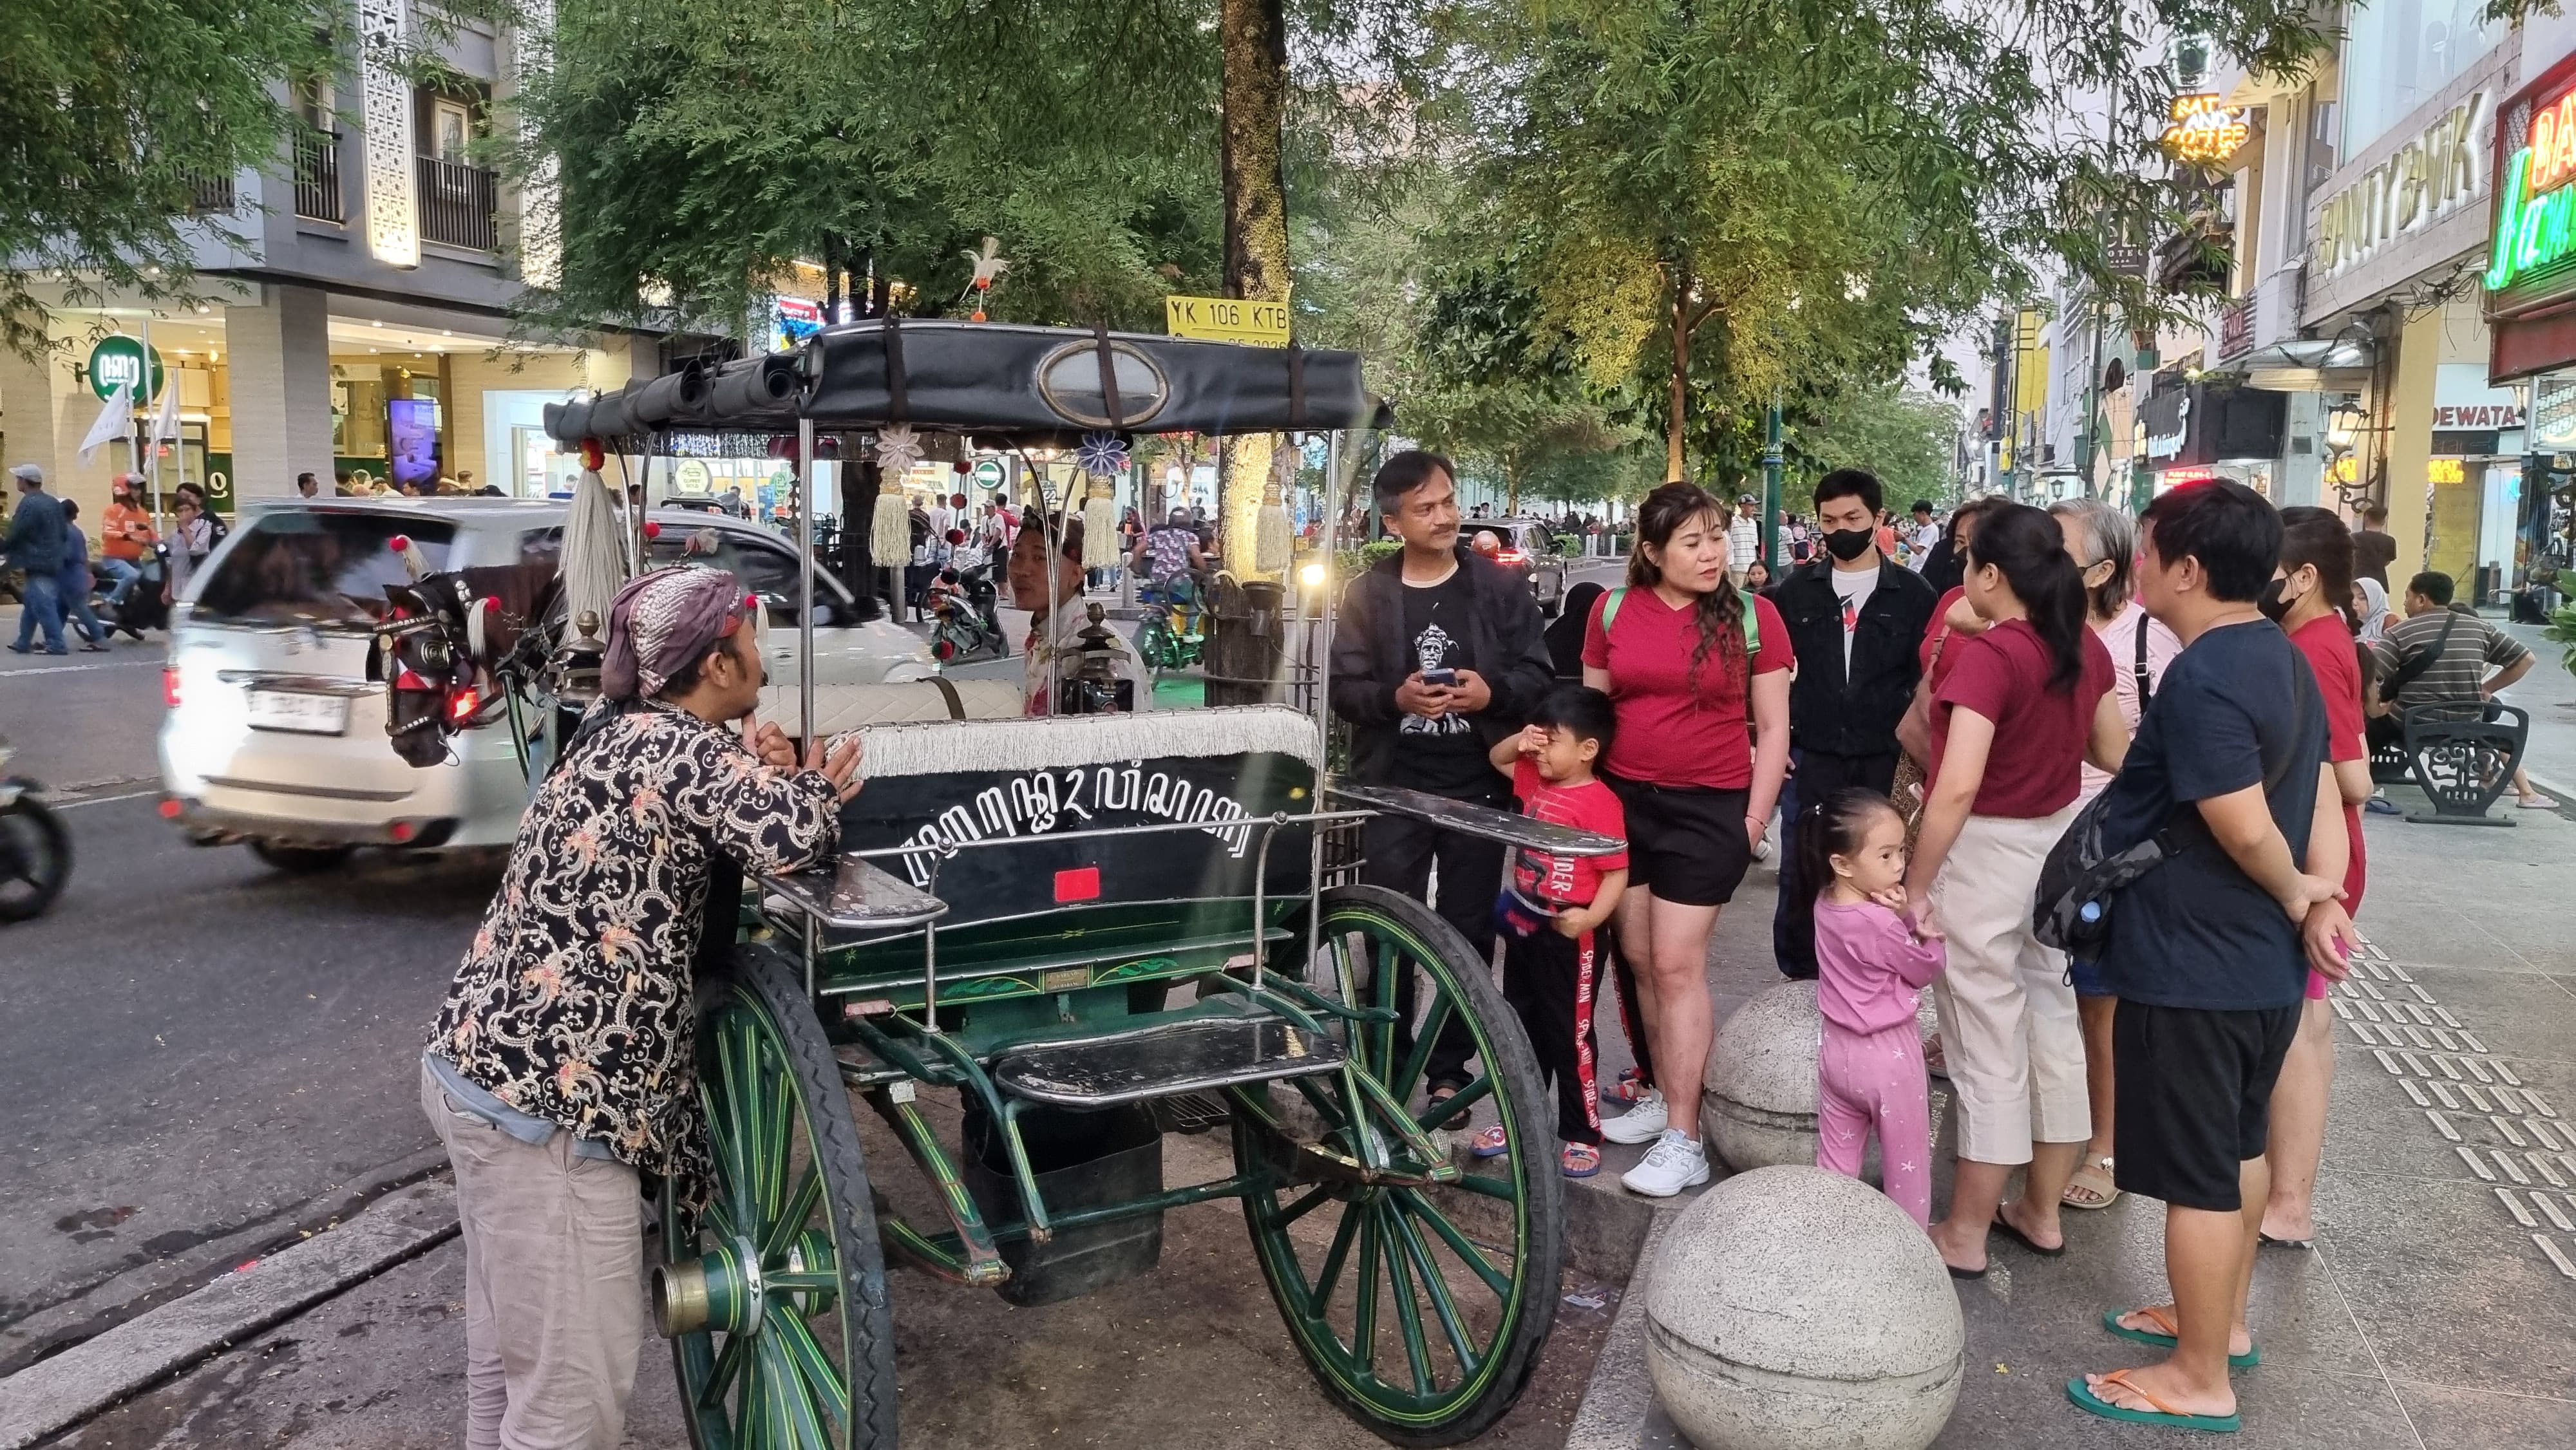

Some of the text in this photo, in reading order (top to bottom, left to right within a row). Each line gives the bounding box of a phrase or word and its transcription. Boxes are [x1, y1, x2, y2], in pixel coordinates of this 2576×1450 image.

[2185, 111, 2231, 129] AND
[2532, 89, 2576, 189] BA
[2098, 249, 2144, 258] OTEL
[1171, 301, 1287, 329] YK 106 KTB
[1551, 856, 1575, 904] IDER-
